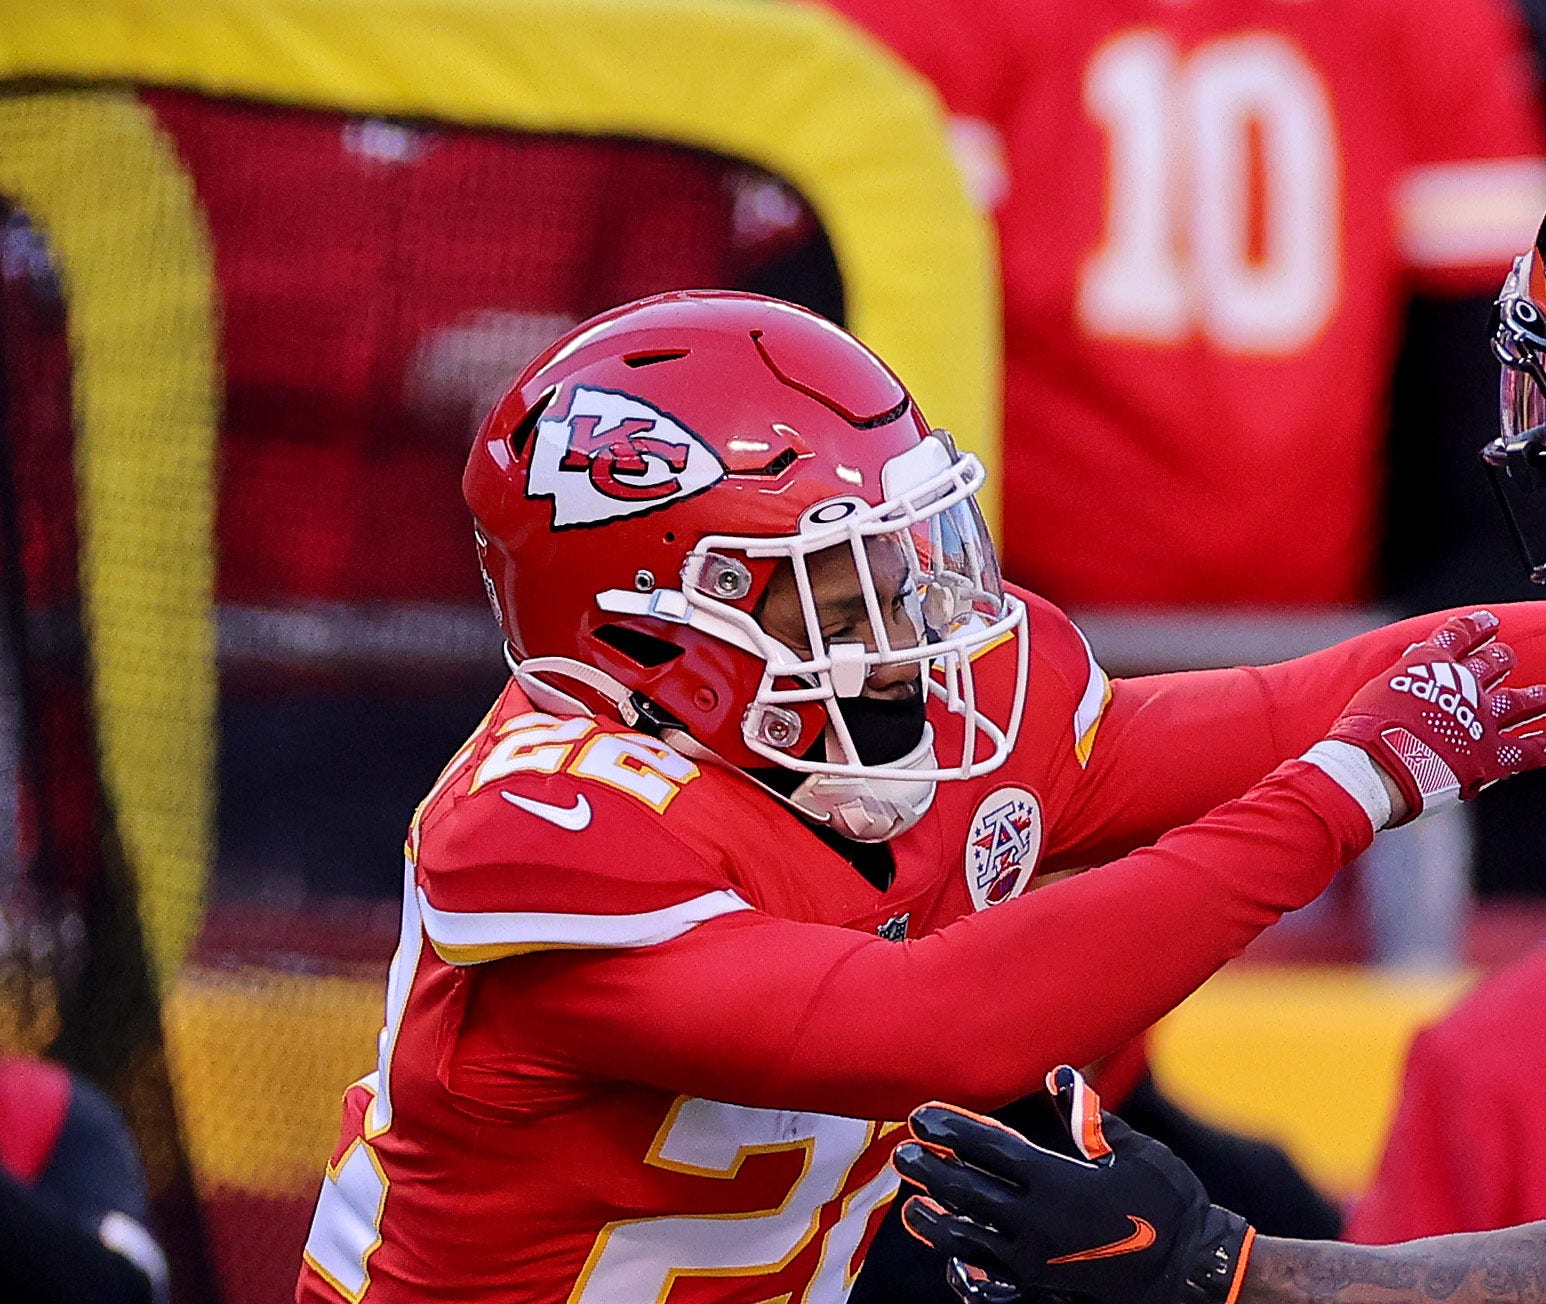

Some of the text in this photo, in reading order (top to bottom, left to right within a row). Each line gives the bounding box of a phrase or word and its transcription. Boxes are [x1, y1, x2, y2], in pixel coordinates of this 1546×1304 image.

[1078, 26, 1348, 356] 10
[559, 414, 690, 501] KC
[1389, 674, 1484, 741] adidas
[467, 711, 702, 815] 22
